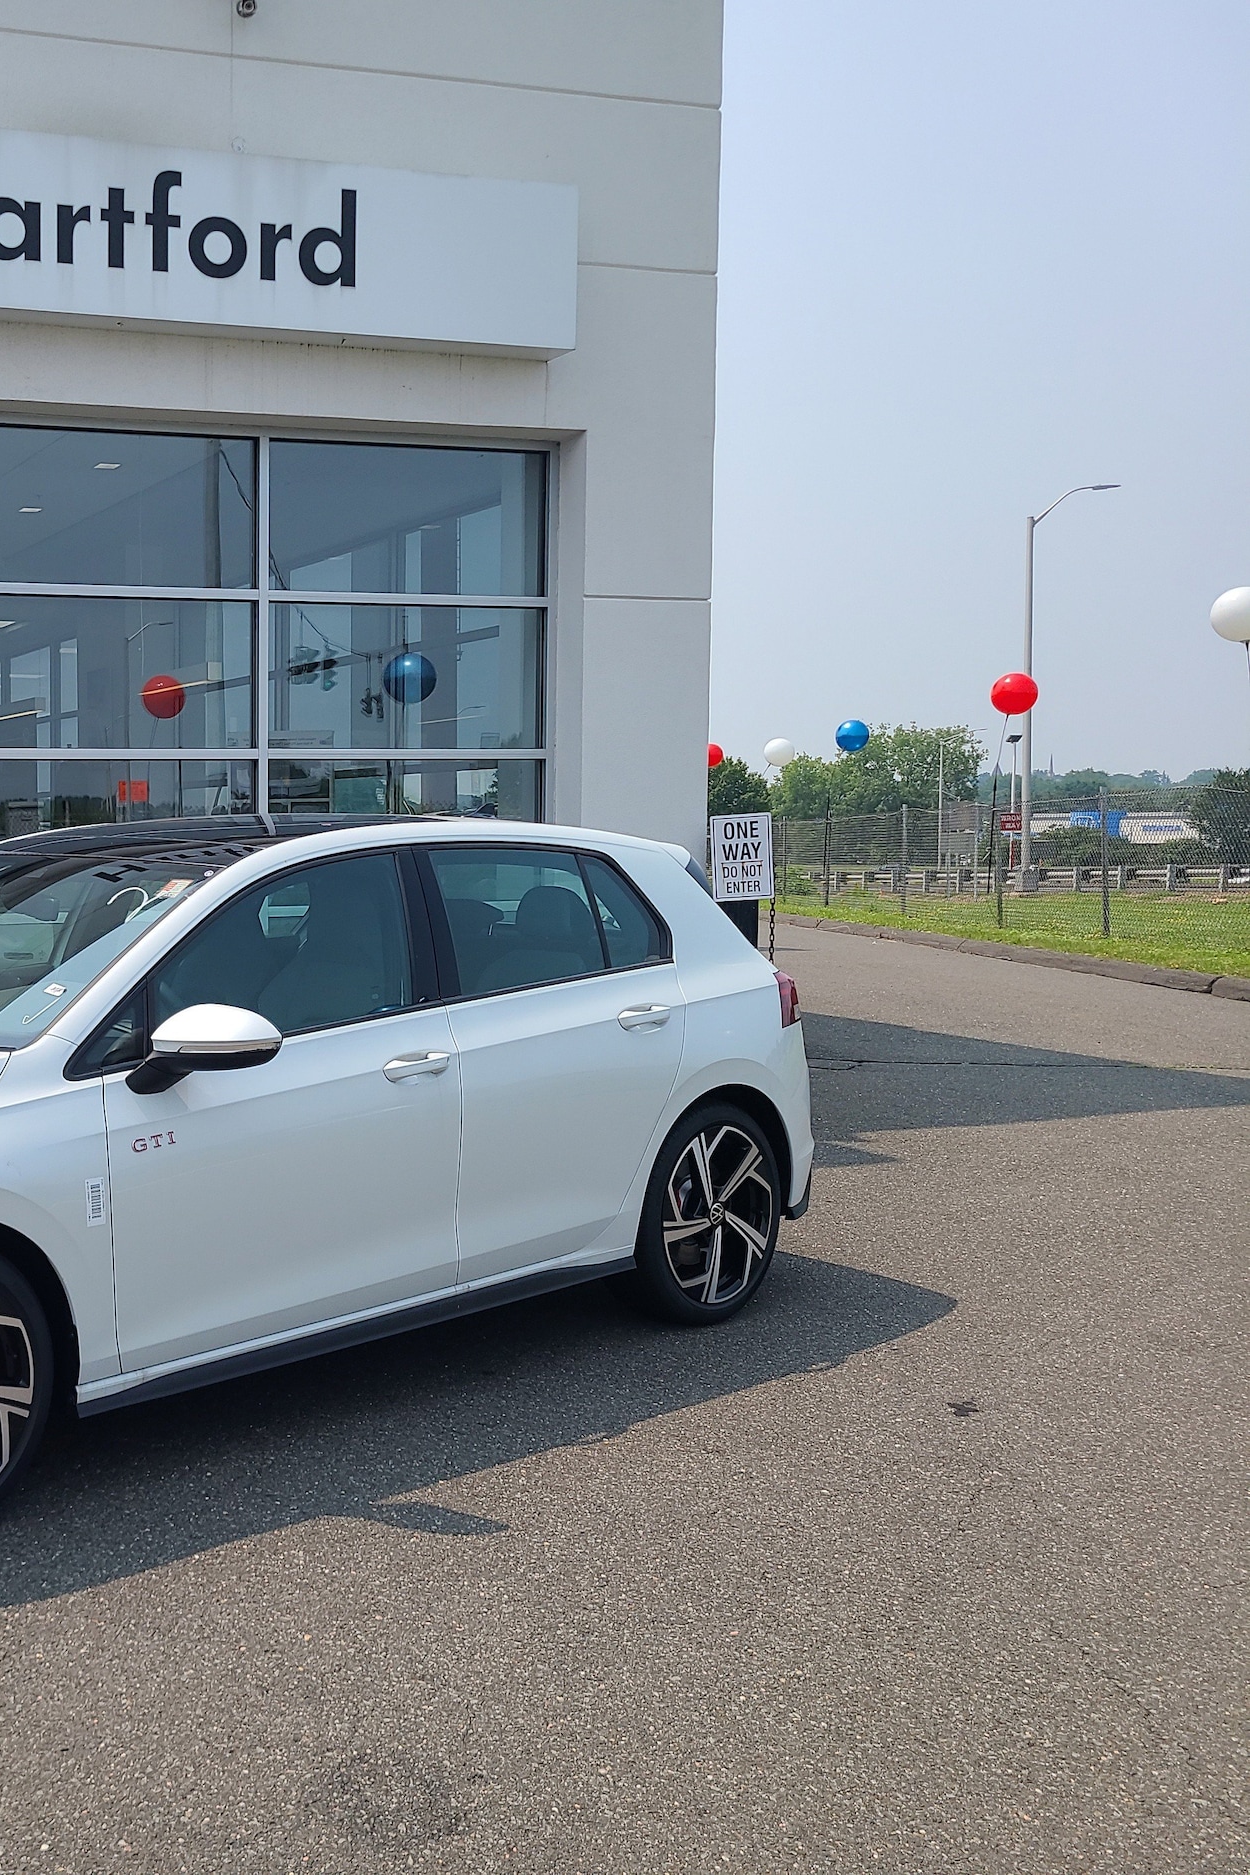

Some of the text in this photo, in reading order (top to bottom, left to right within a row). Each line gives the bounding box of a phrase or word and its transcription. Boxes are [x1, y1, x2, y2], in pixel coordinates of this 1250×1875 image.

[723, 821, 759, 840] ONE
[722, 841, 761, 861] WAY
[723, 864, 762, 879] DO NOT
[726, 880, 761, 893] ENTER
[131, 1131, 176, 1153] GTI
